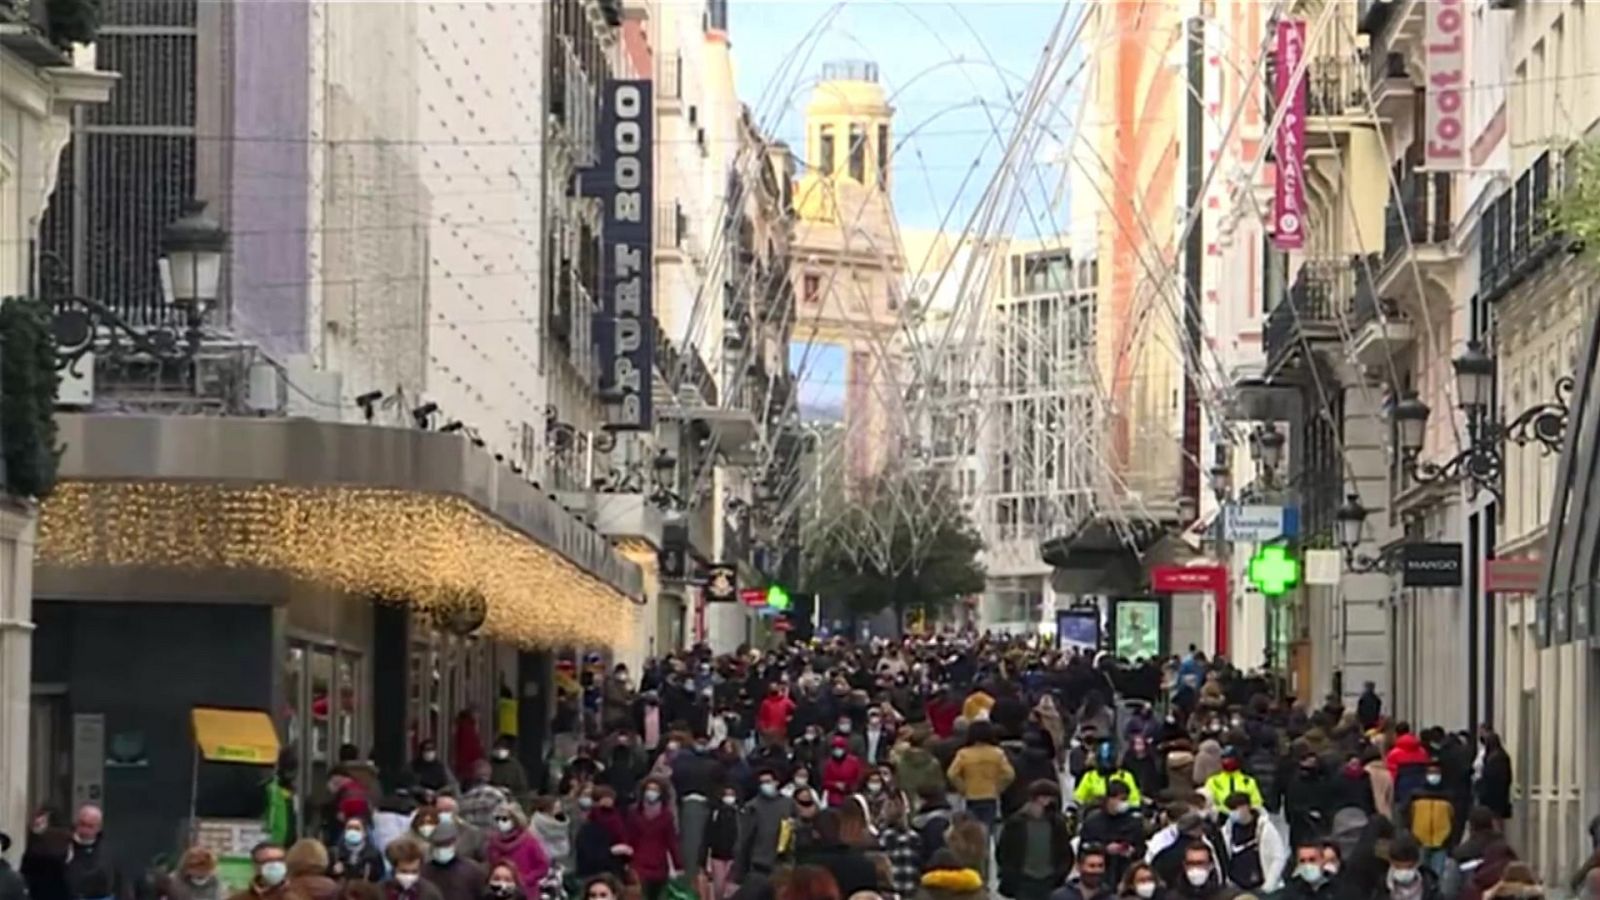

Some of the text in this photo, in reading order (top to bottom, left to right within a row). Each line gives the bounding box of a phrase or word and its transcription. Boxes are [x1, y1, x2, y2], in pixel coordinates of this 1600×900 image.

[1427, 0, 1461, 158] Foot Lo
[614, 85, 641, 221] 2000
[1285, 114, 1297, 209] PALACE
[1408, 560, 1457, 570] MANGO
